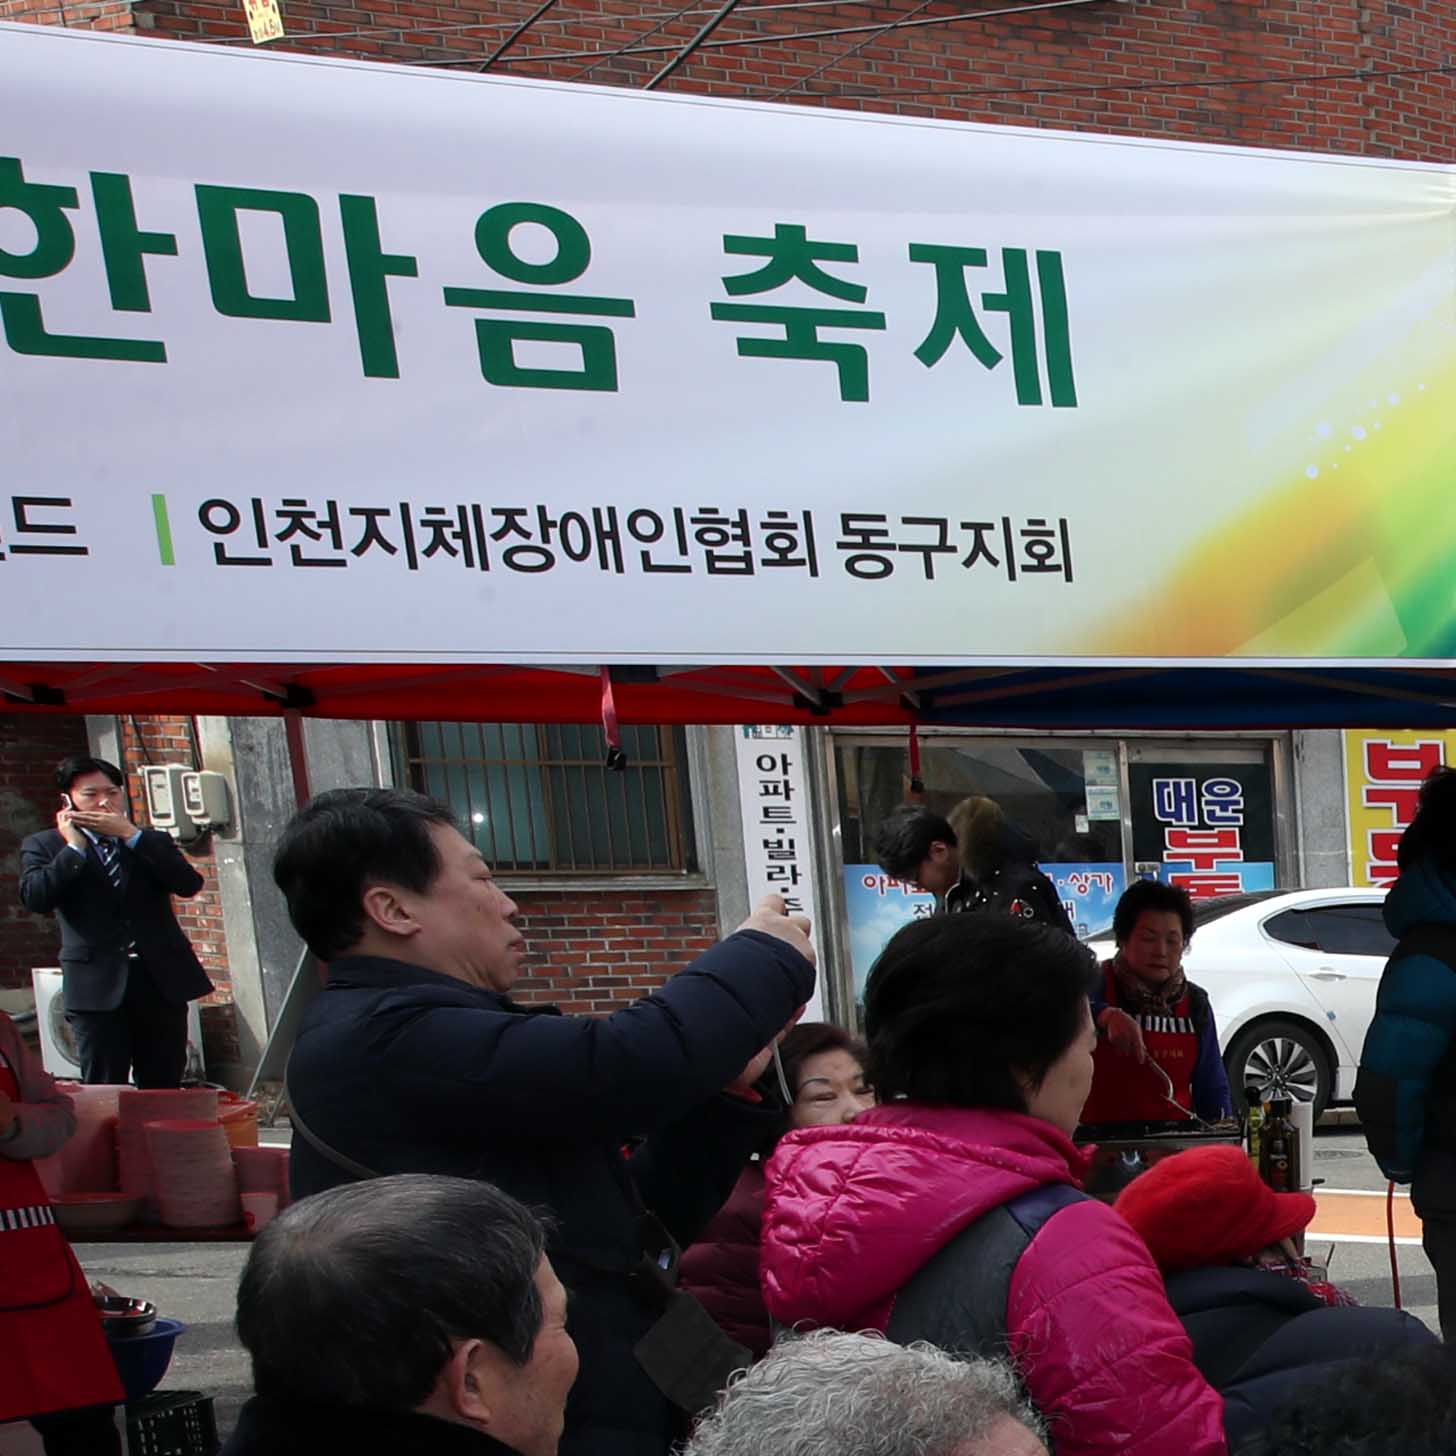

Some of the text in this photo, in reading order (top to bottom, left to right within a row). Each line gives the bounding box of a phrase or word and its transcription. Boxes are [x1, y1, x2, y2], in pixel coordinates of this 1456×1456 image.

[0, 155, 1079, 409] 한마음 축제
[0, 495, 1074, 584] 드 인천지체장애인협회 동구지회
[1153, 777, 1244, 826] 대운
